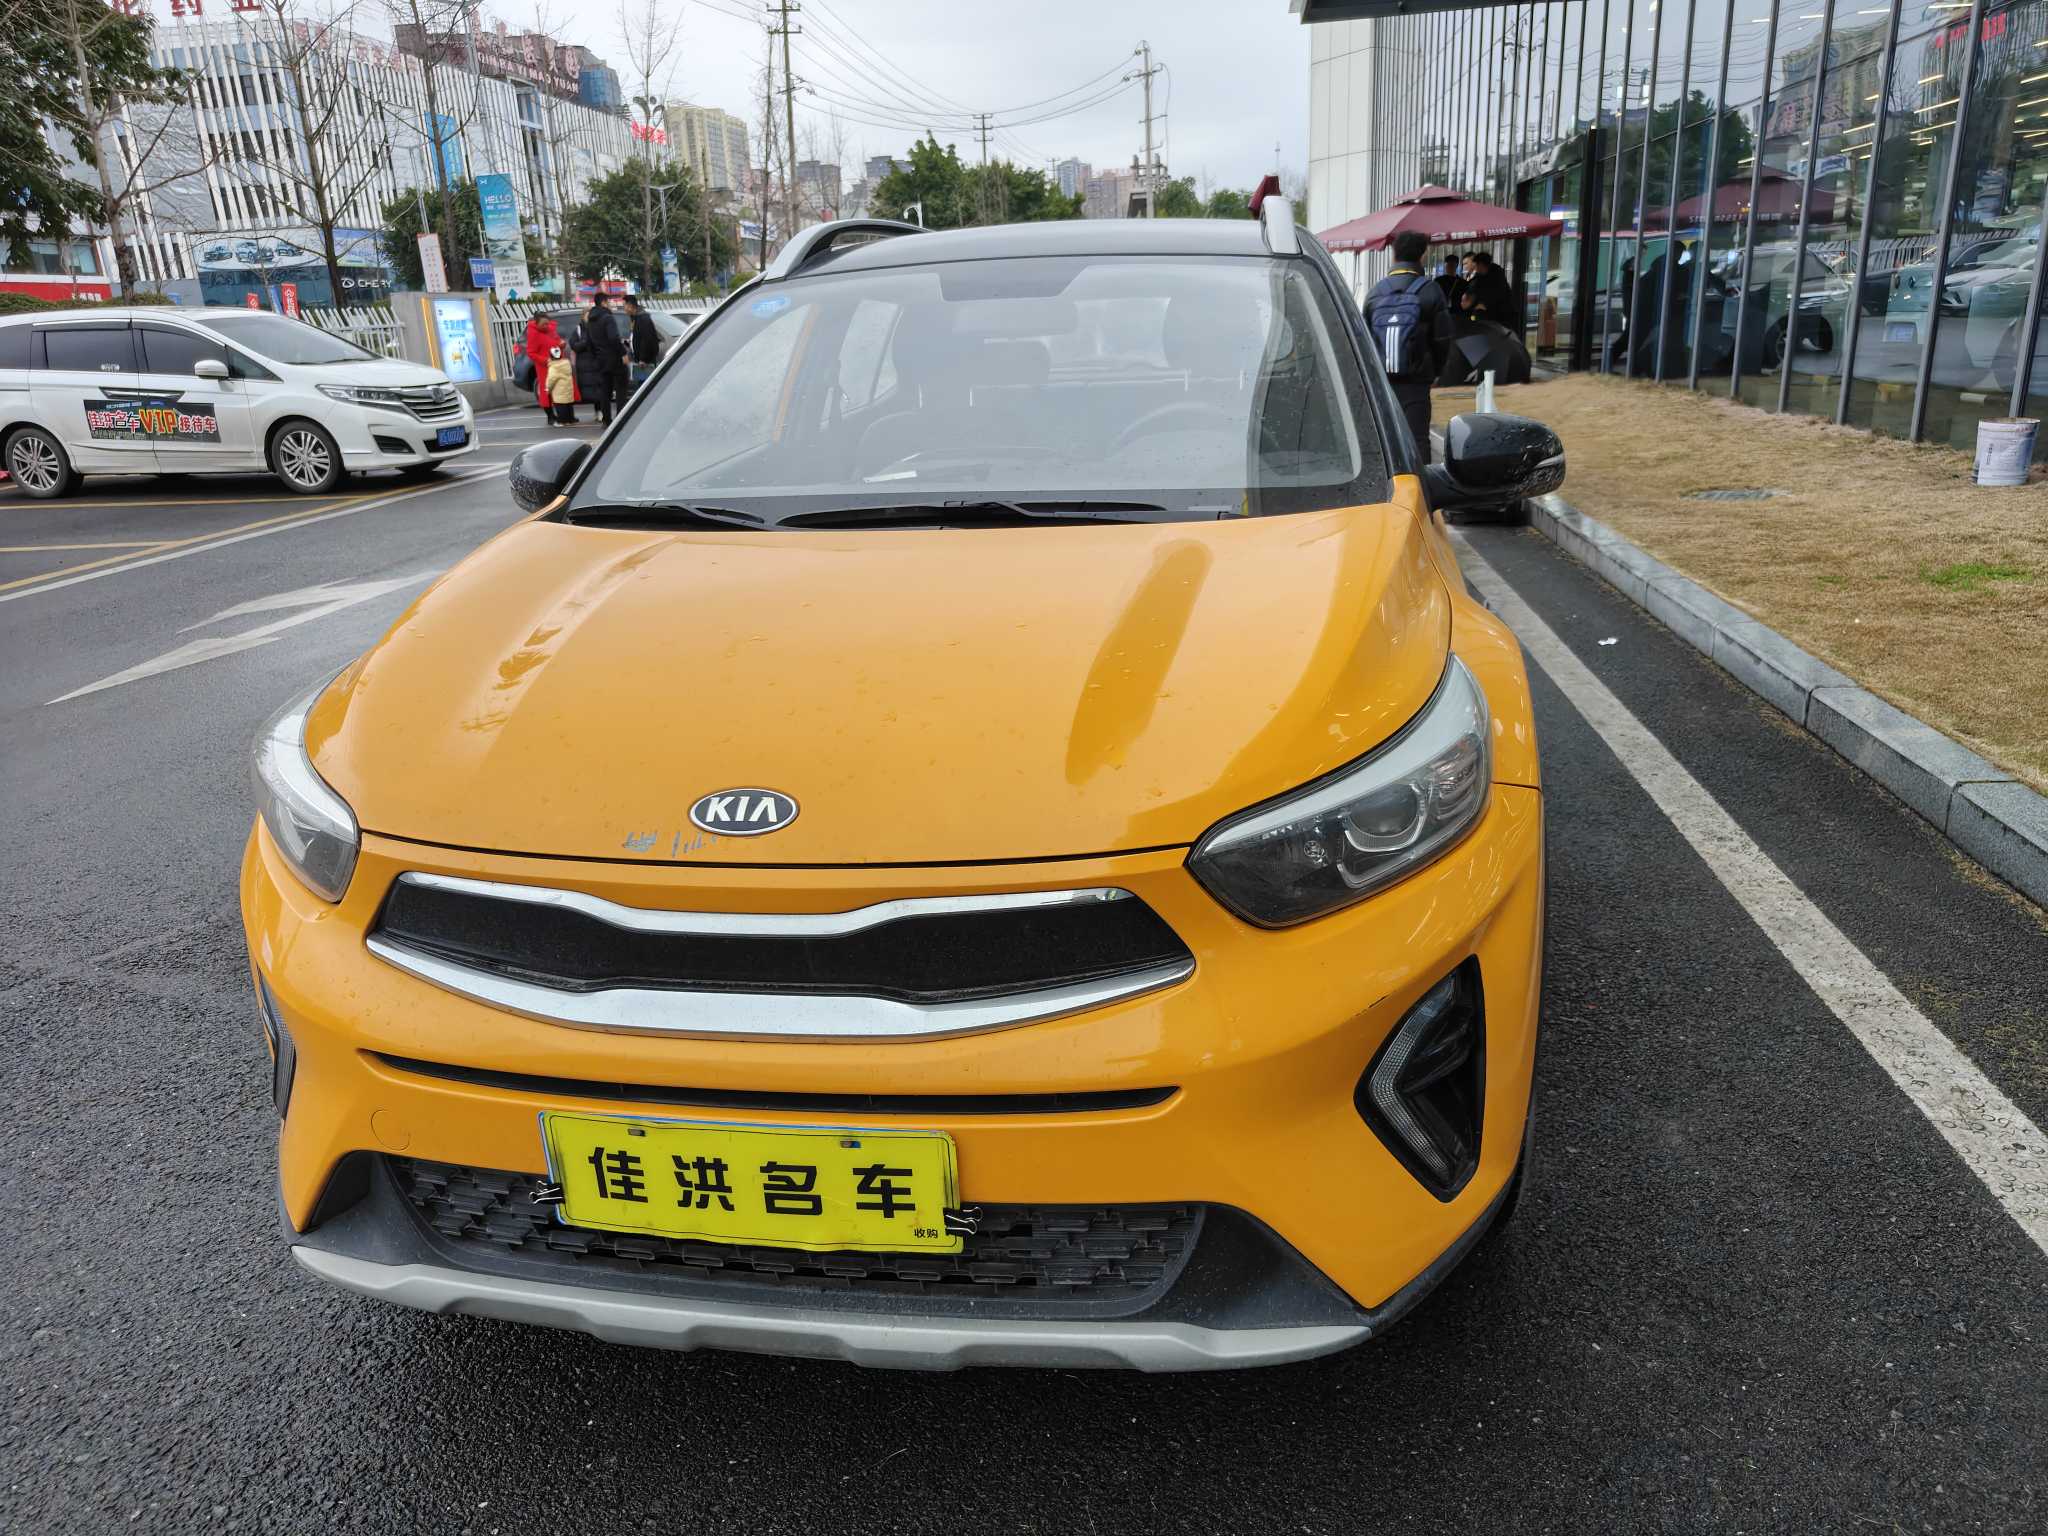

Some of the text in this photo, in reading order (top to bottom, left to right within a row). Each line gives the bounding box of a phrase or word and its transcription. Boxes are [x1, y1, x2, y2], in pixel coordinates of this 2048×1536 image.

[357, 279, 392, 288] CHERY
[705, 795, 778, 824] KIA
[587, 1146, 917, 1219] 佳洪名车
[913, 1228, 939, 1239] 收购
